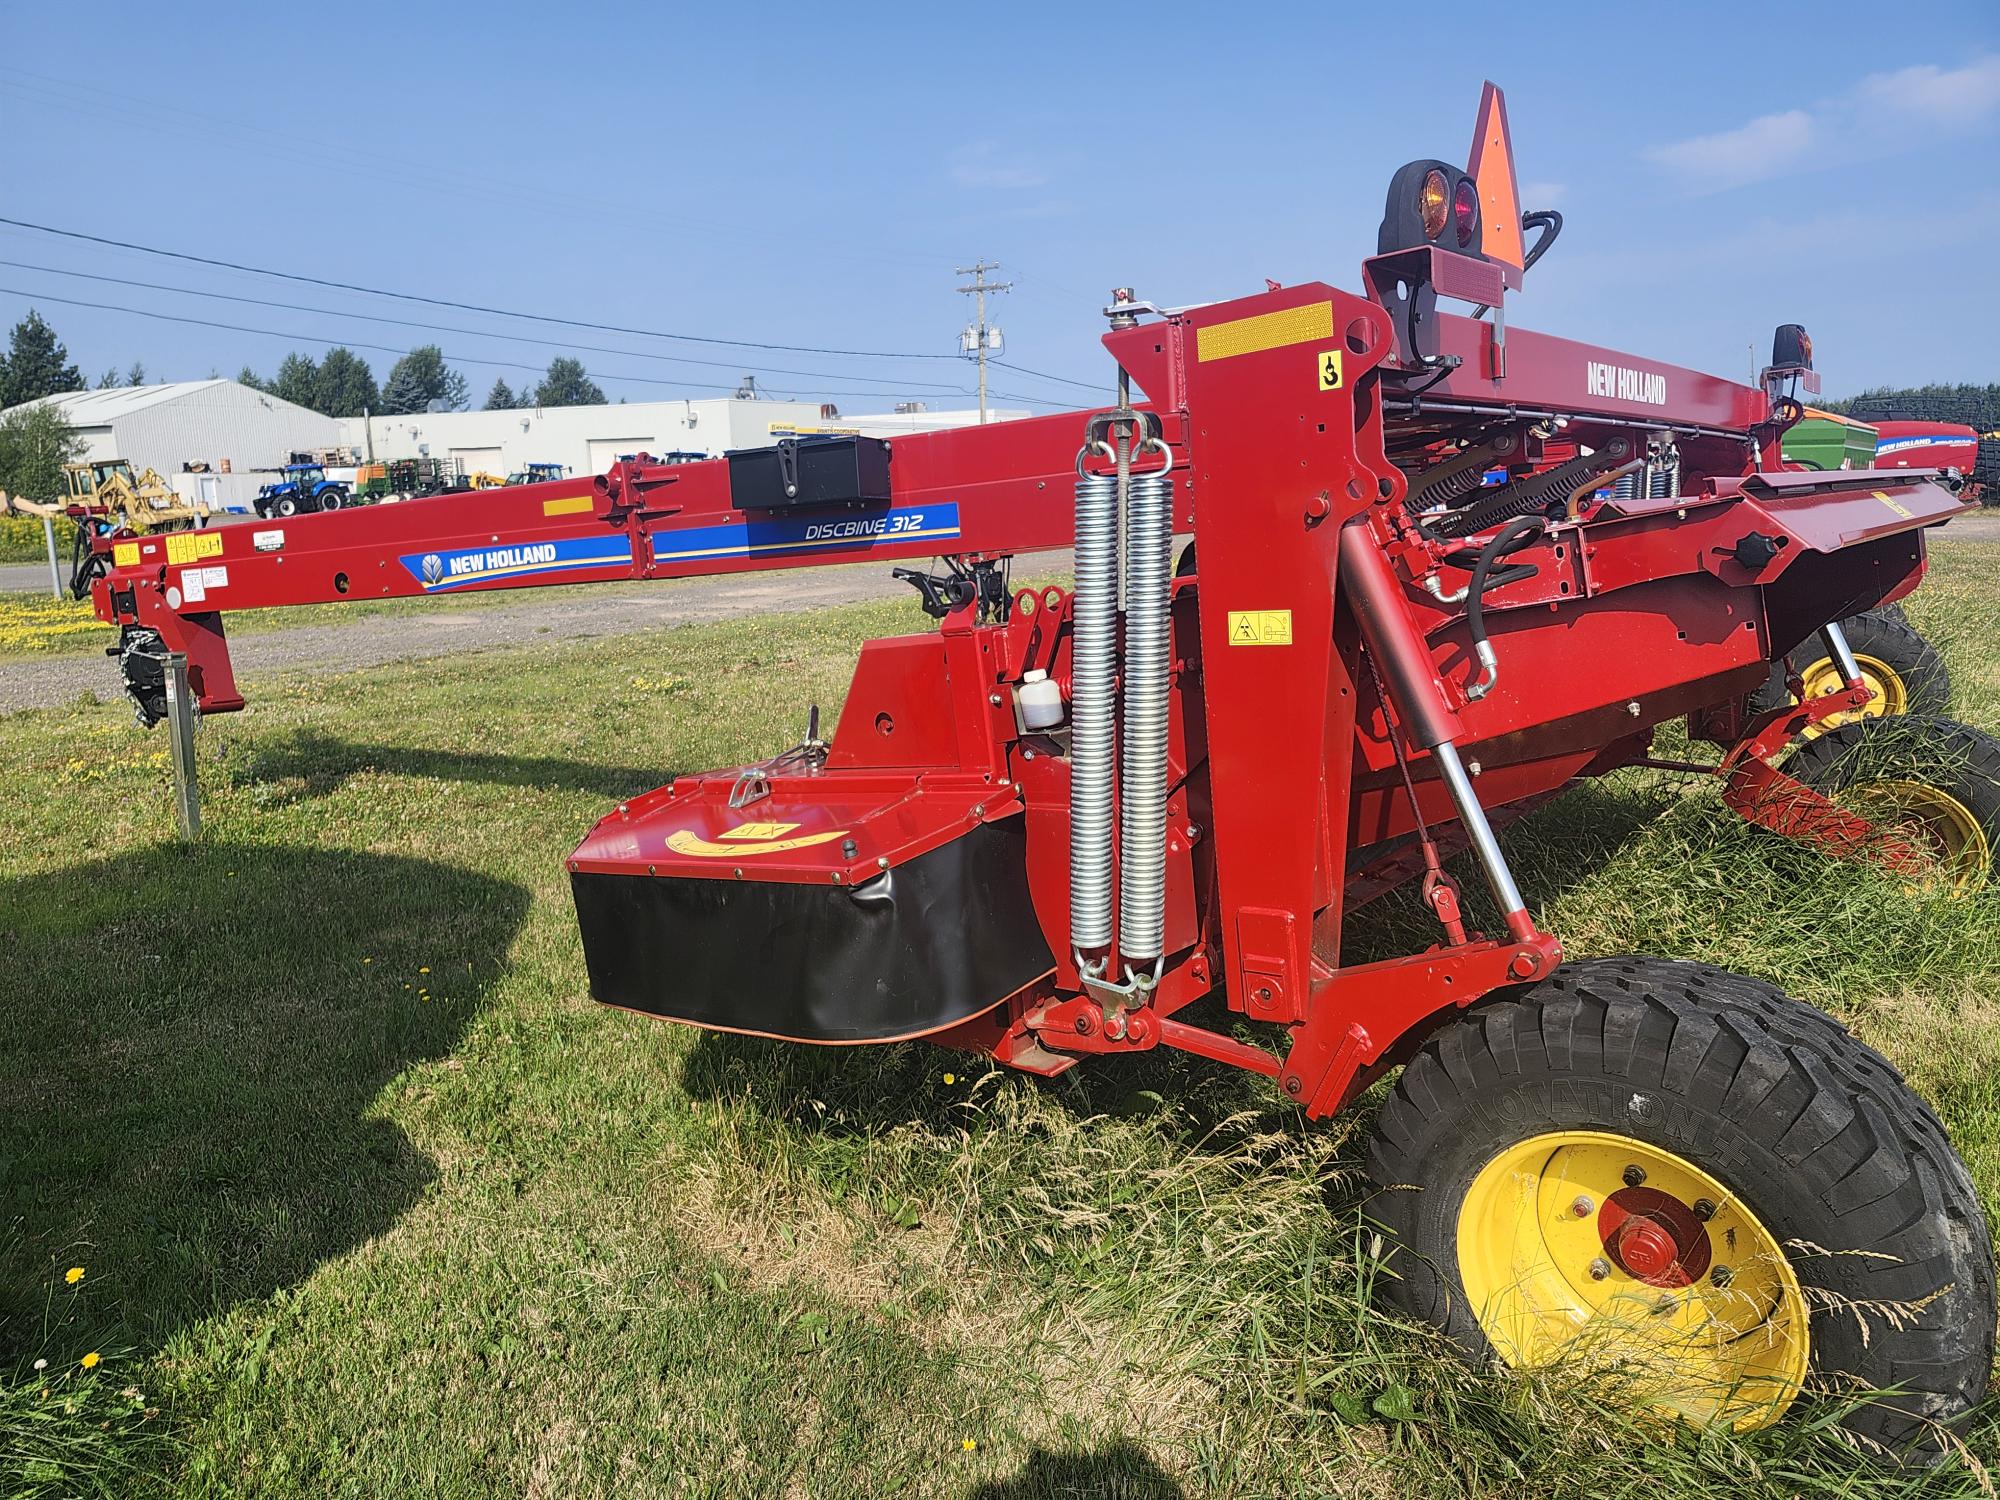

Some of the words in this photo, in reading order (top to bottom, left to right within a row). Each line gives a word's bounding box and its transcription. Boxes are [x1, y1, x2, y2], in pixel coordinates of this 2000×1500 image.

[1587, 361, 1616, 398] NEW
[1618, 367, 1666, 405] HOLLAND
[1878, 444, 1896, 453] NEW
[1896, 438, 1931, 449] HOLLAND
[805, 518, 888, 540] DISCBINE
[889, 515, 924, 533] 312
[450, 555, 484, 575] NEW
[486, 544, 556, 569] HOLLAND
[1448, 1079, 1705, 1146] FLOTATION
